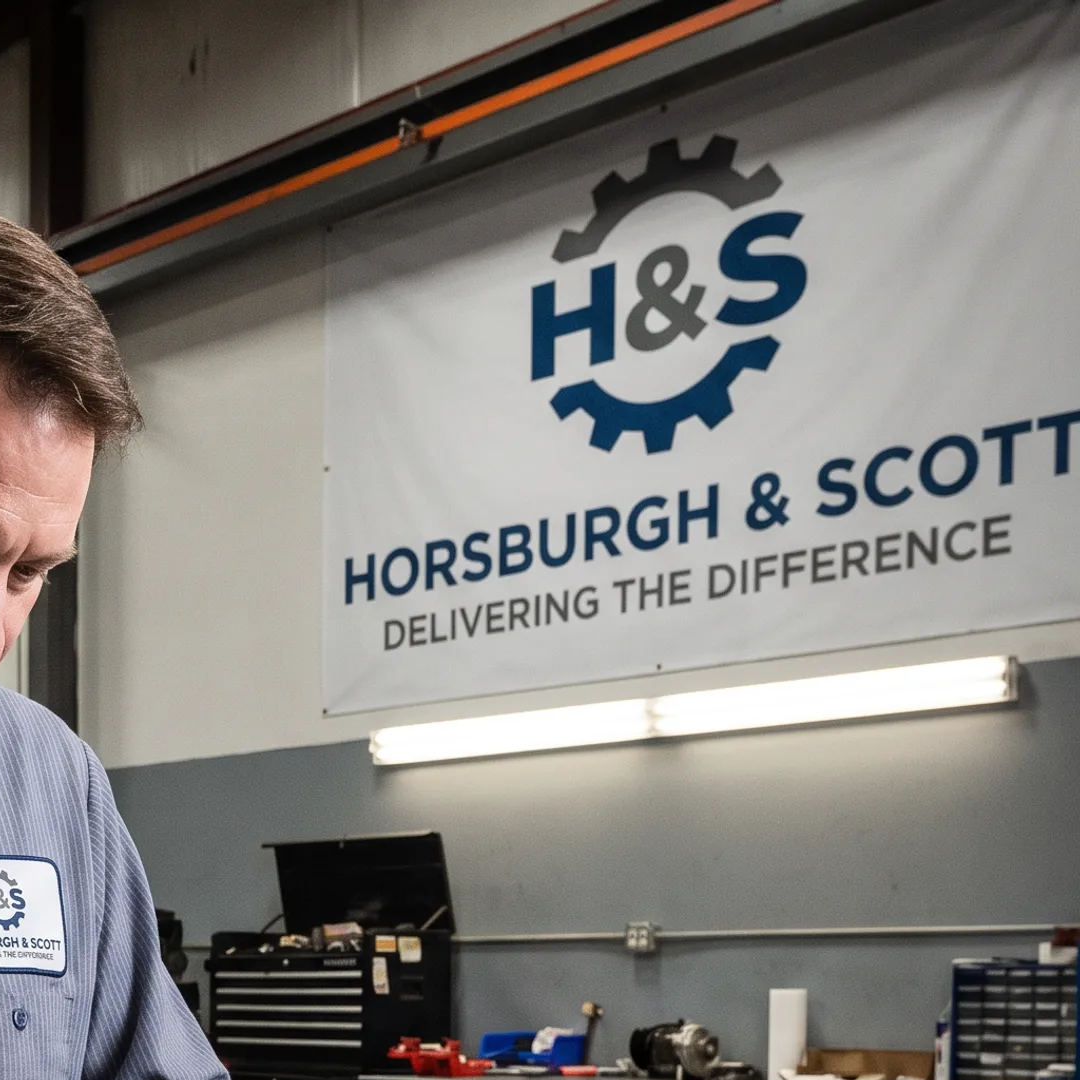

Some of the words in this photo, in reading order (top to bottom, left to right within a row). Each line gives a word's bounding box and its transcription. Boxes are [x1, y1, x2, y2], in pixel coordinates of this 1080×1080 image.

[531, 210, 808, 381] H&S
[344, 483, 720, 605] HORSBURGH
[745, 472, 791, 531] &
[816, 408, 1080, 517] SCOTT
[383, 585, 600, 651] DELIVERING
[613, 569, 692, 613] THE
[707, 514, 1013, 599] DIFFERENCE
[22, 937, 29, 949] &
[30, 937, 61, 951] SCOTT
